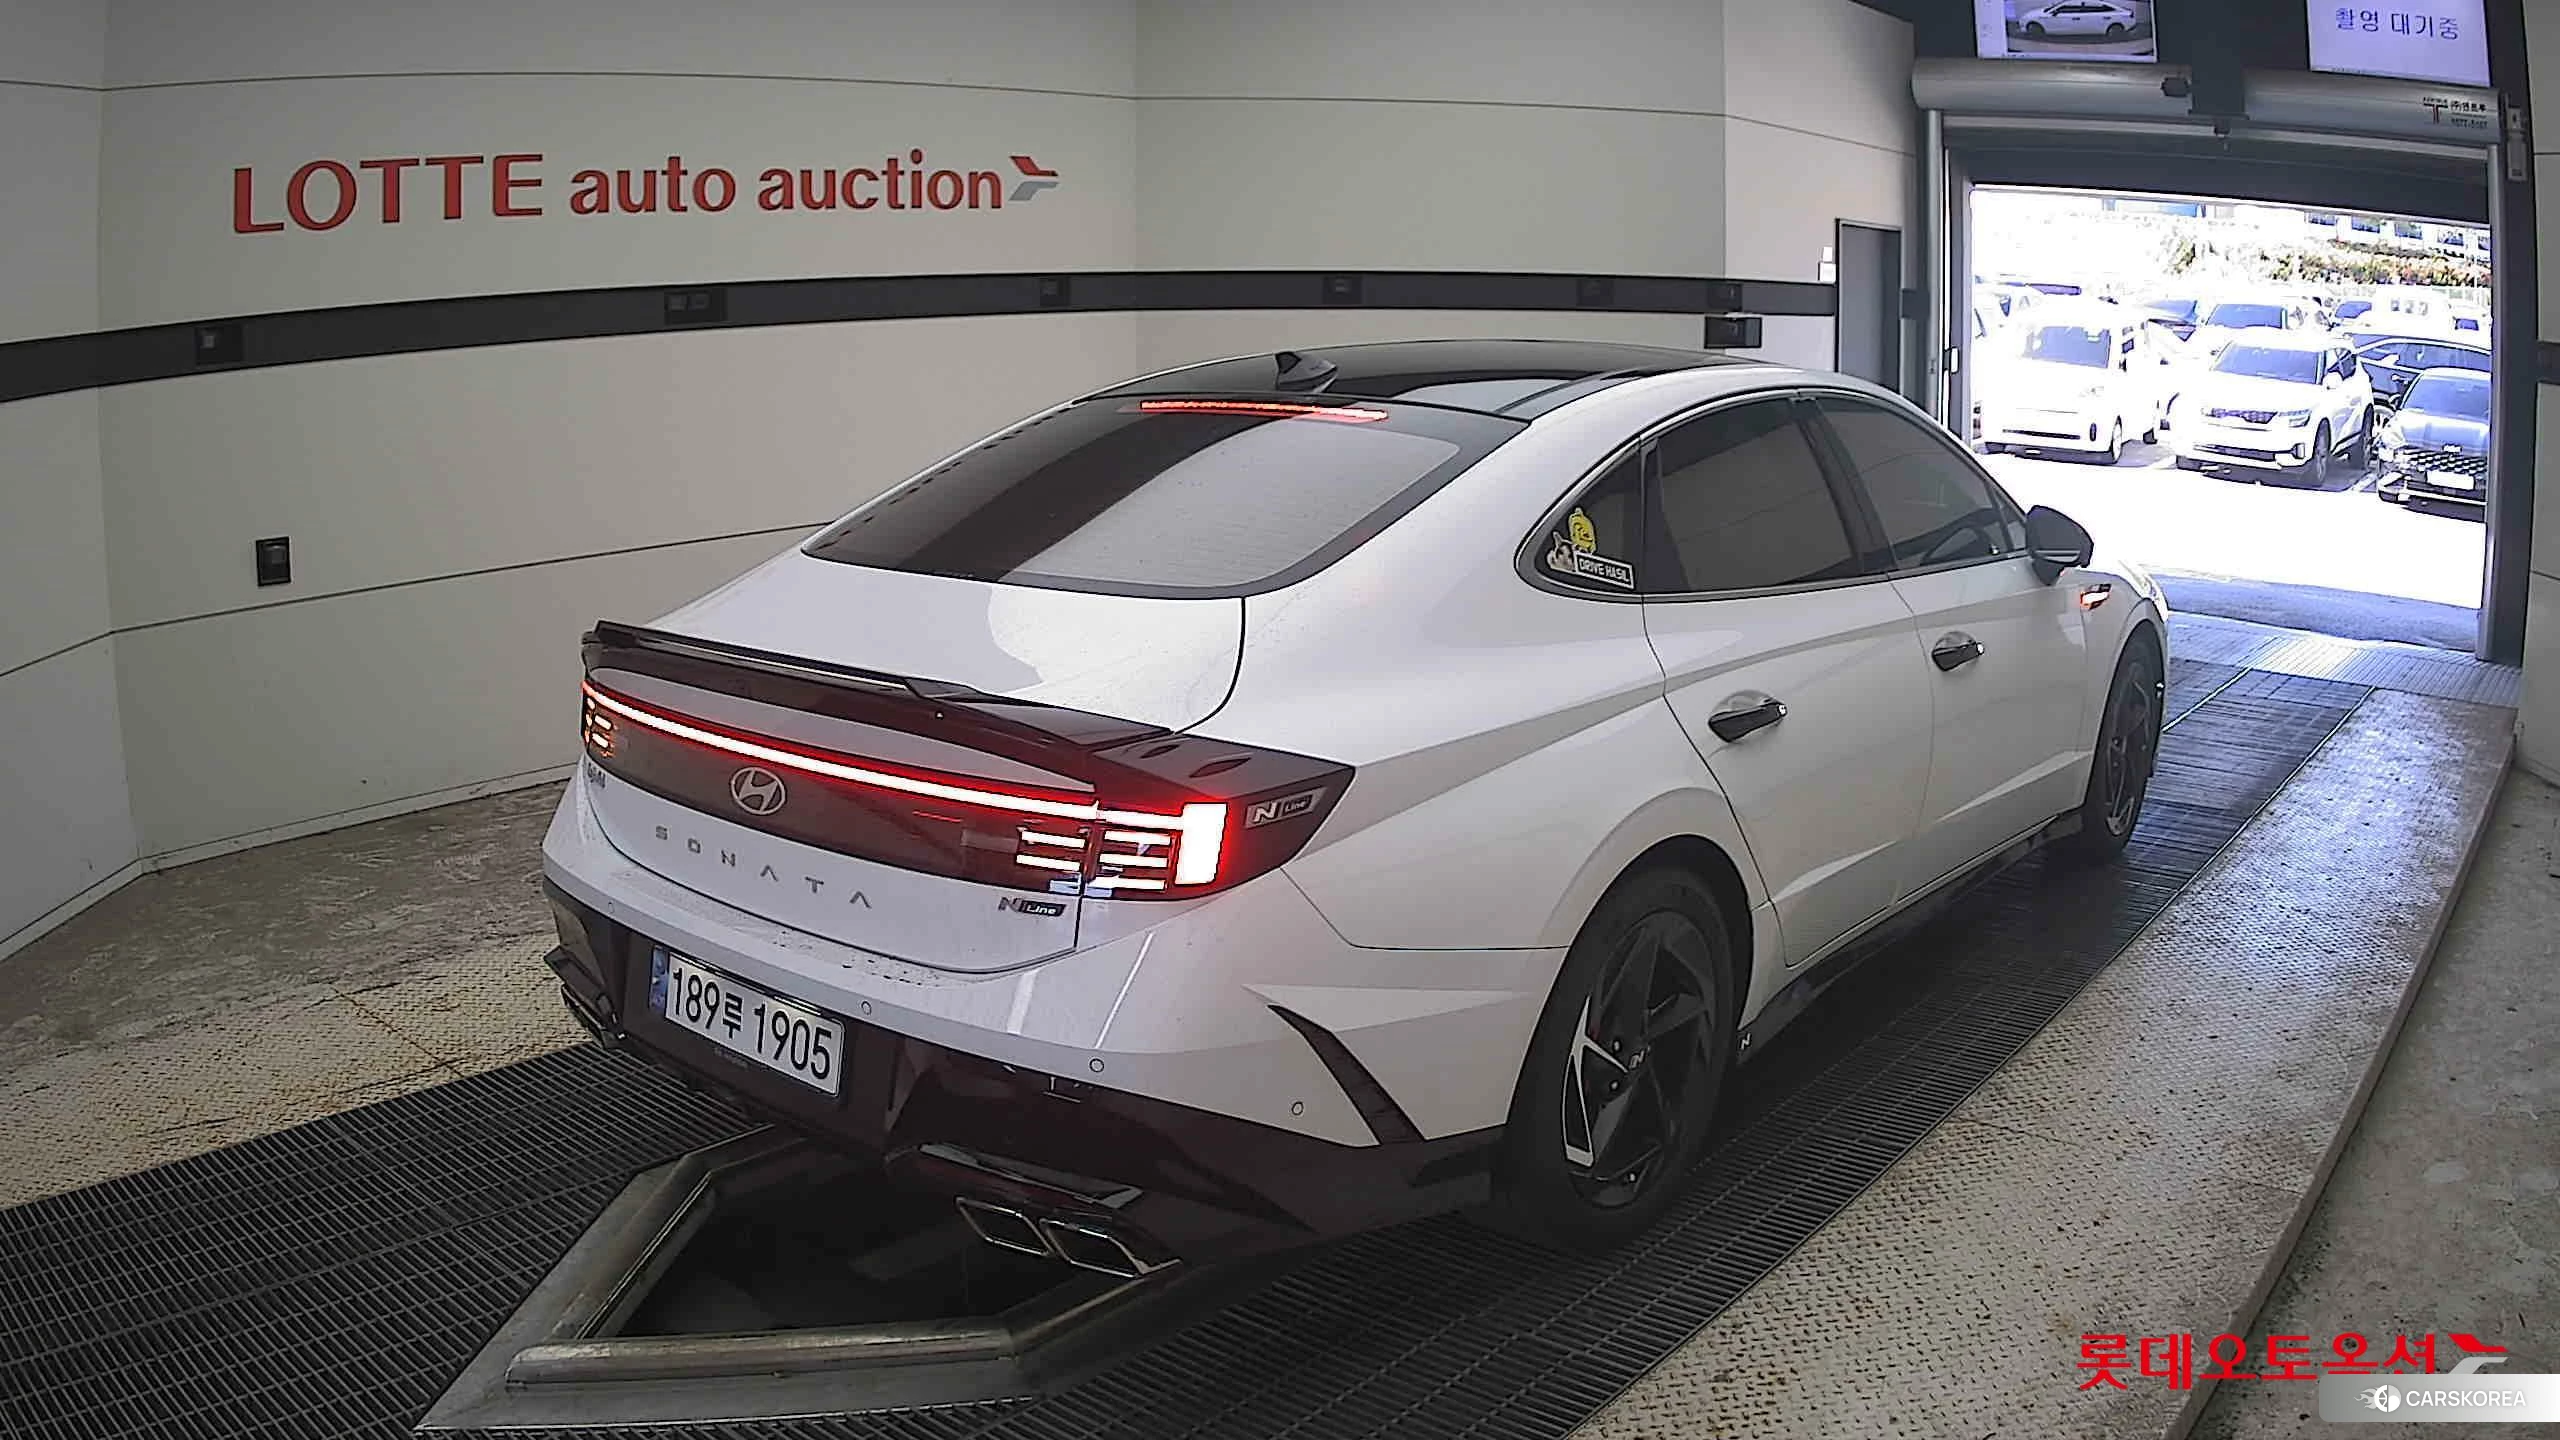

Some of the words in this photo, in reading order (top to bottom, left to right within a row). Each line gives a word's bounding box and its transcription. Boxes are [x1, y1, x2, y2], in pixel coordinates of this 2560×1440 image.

[2336, 8, 2378, 32] 촬영
[2391, 13, 2459, 40] 대기중
[233, 154, 543, 234] LOTTE
[569, 154, 737, 215] auto
[757, 148, 1003, 212] auction
[1253, 801, 1279, 823] N
[655, 825, 872, 910] SONATA
[1026, 904, 1057, 915] Line
[673, 967, 743, 1039] 189루
[754, 1003, 832, 1080] 1905
